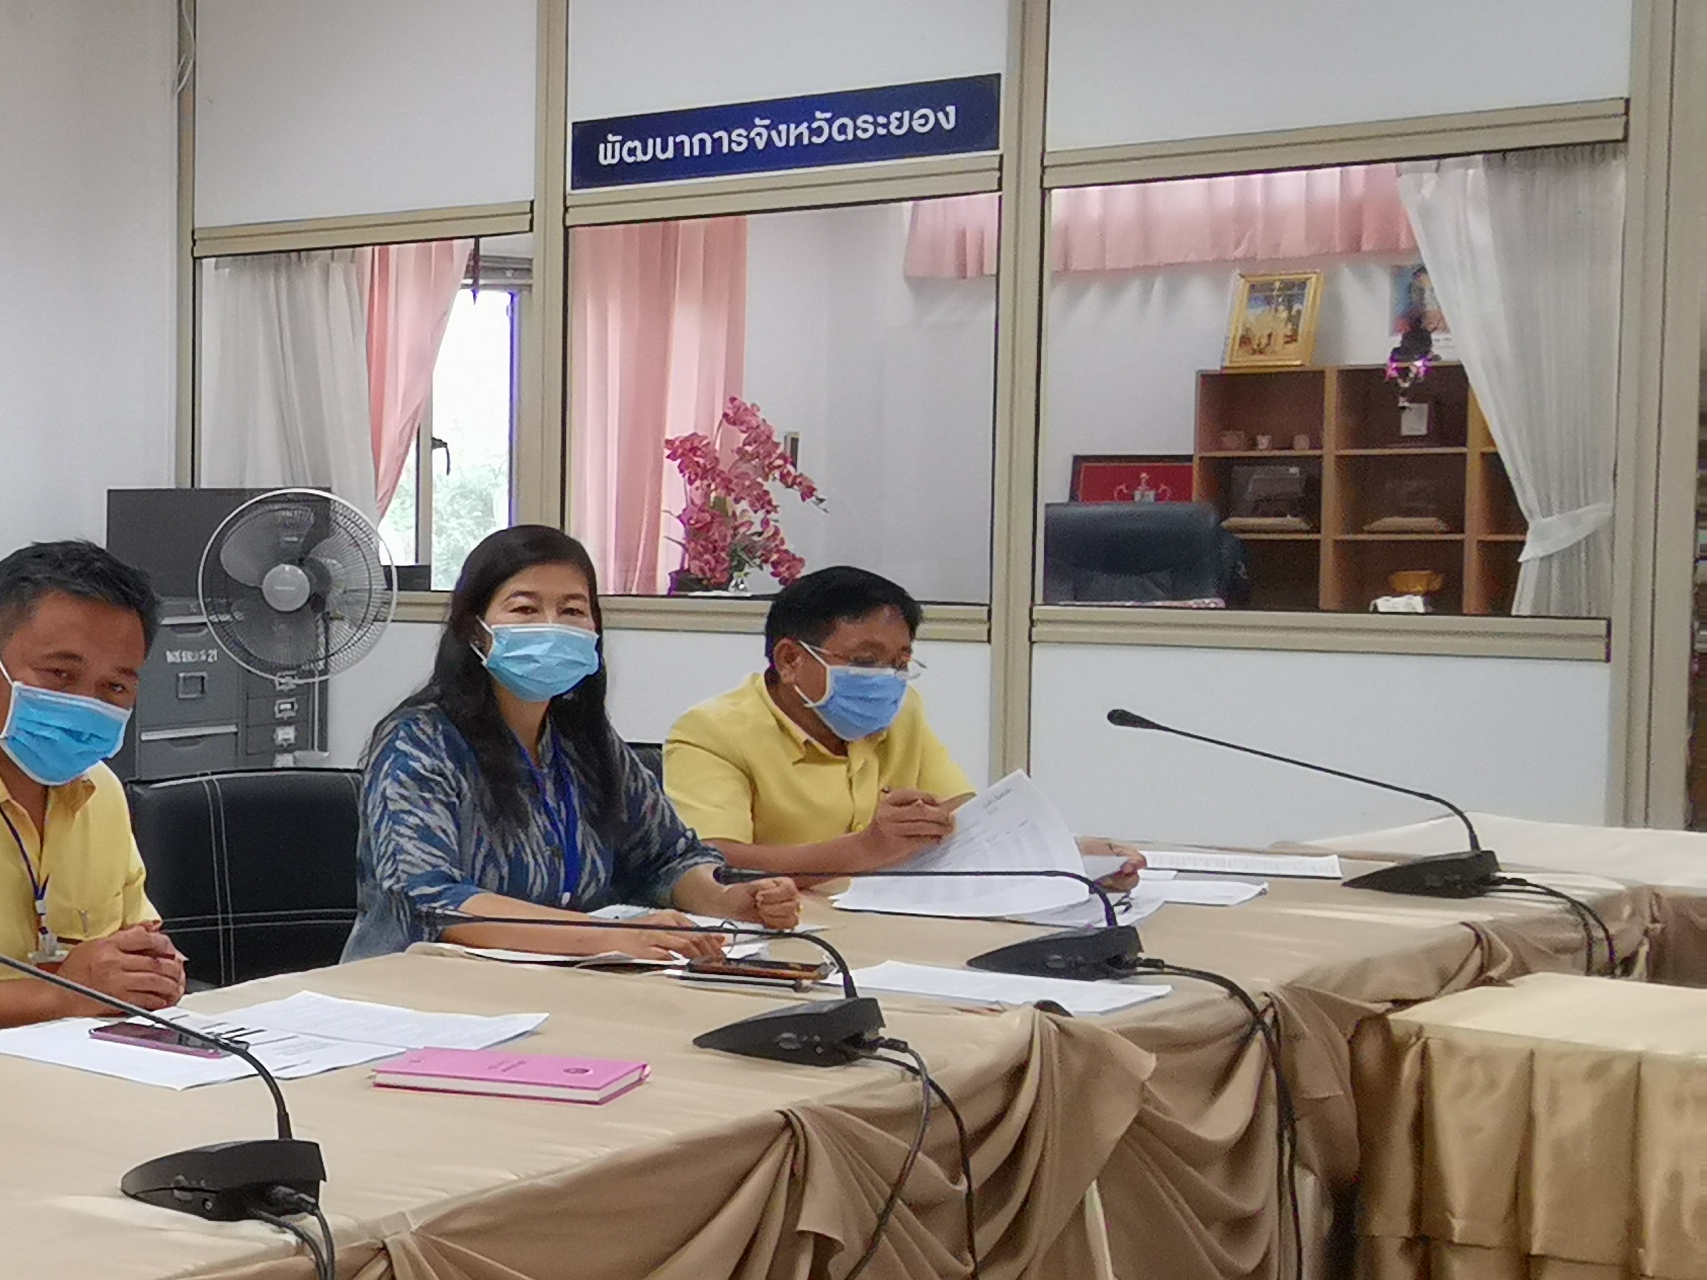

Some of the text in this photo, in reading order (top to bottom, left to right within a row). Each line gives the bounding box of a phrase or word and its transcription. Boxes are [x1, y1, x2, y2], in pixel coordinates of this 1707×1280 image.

[597, 102, 958, 167] พัฒนาการจังหวัดระยอง
